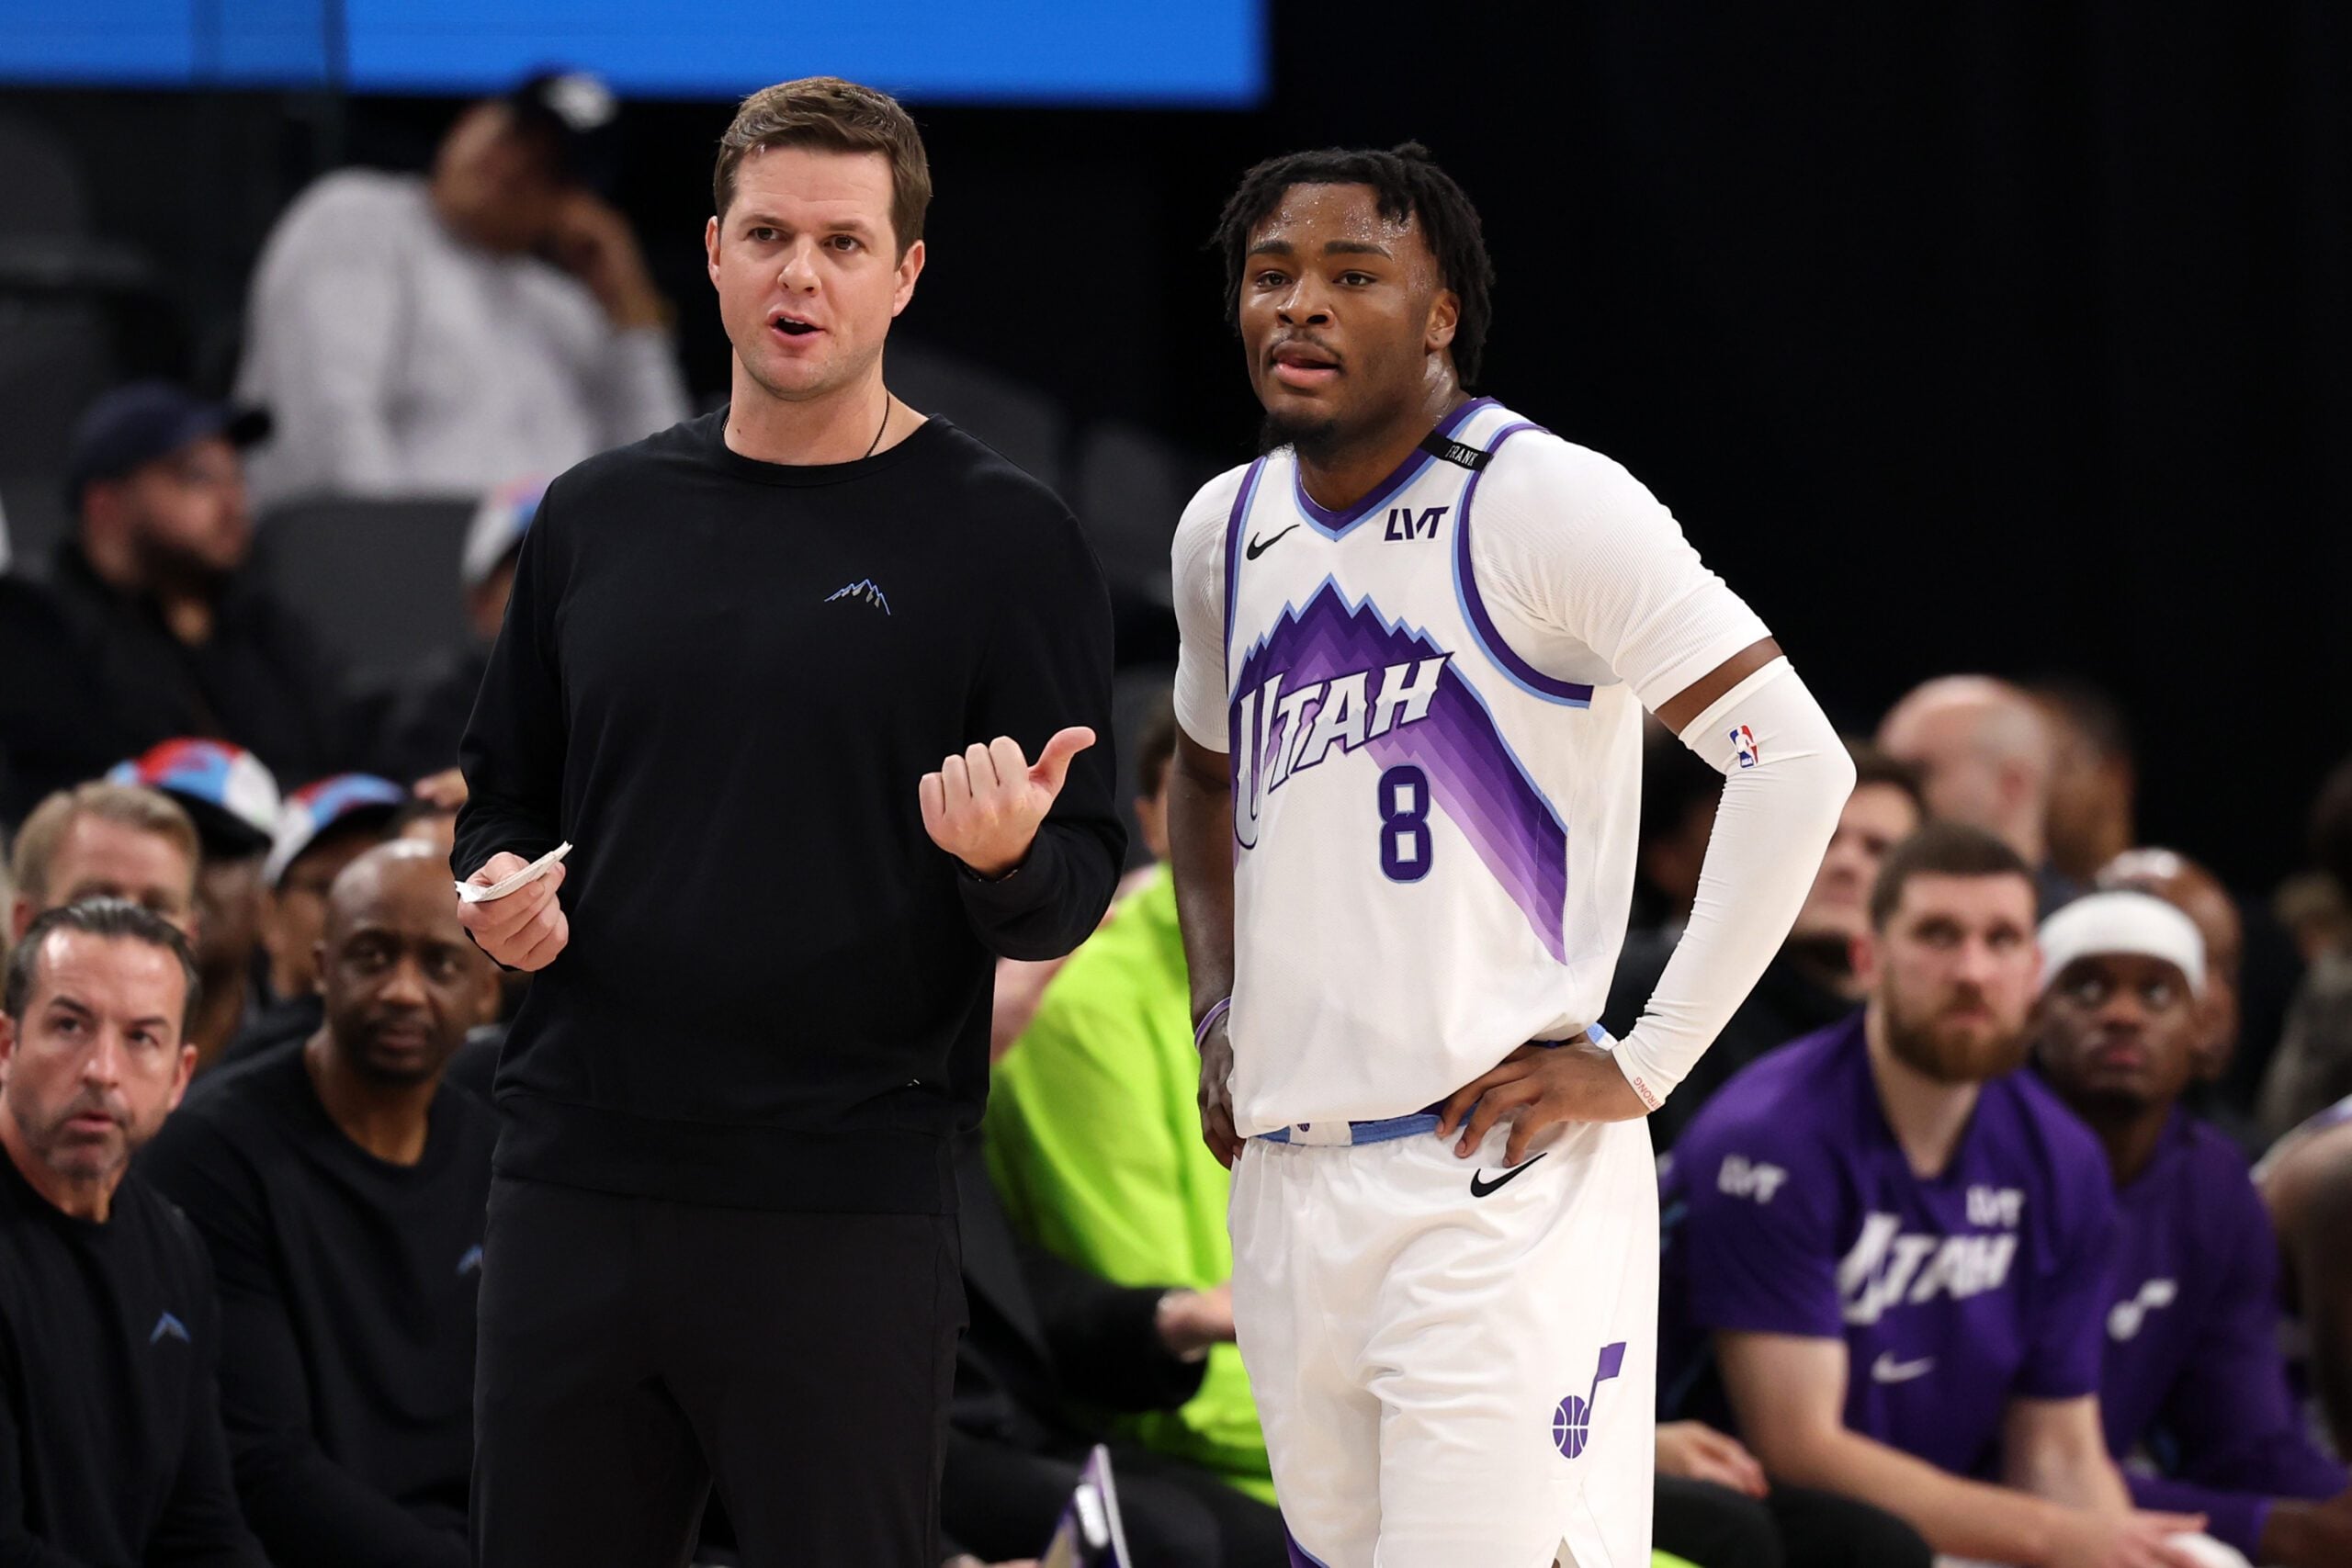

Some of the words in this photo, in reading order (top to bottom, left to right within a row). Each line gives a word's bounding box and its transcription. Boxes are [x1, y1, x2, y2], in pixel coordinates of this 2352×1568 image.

[1445, 445, 1479, 467] FRANK
[1385, 506, 1450, 542] LVT
[1235, 651, 1454, 850] UTAH
[1378, 764, 1433, 884] 8
